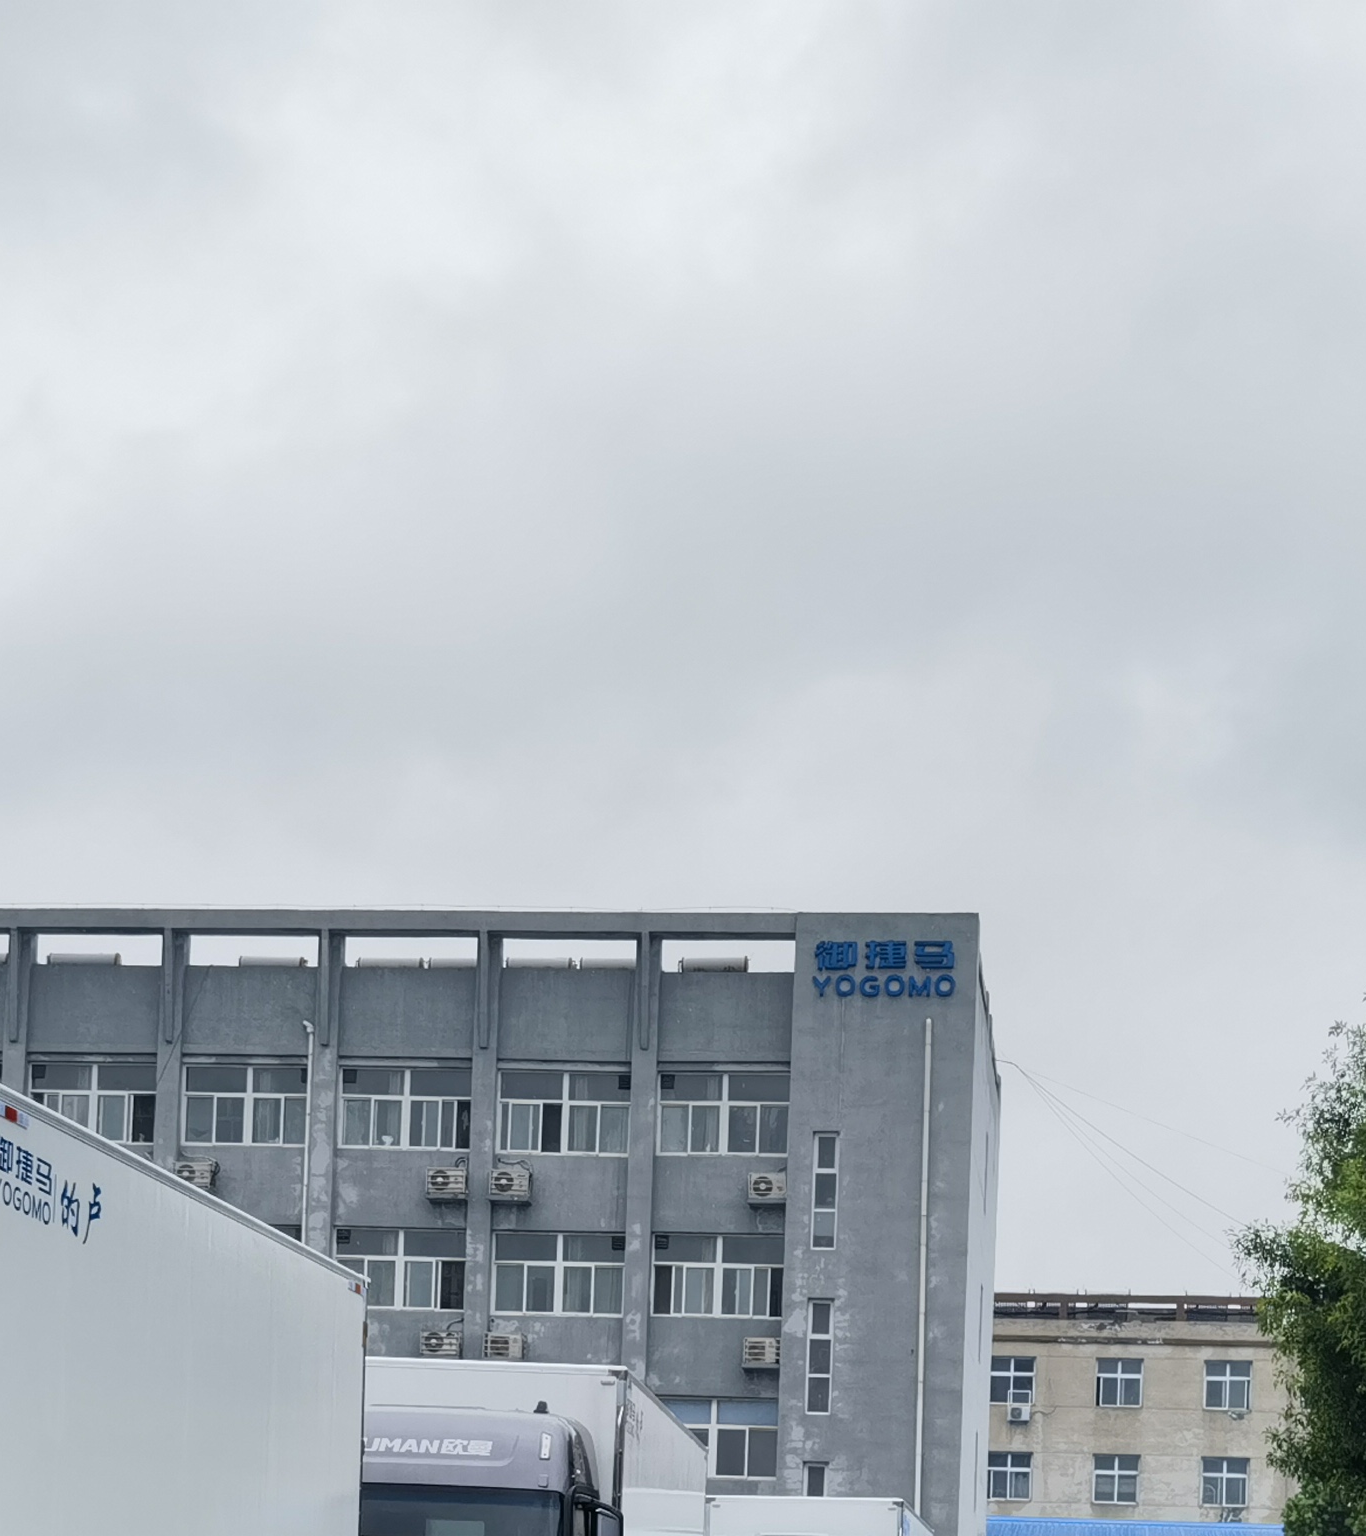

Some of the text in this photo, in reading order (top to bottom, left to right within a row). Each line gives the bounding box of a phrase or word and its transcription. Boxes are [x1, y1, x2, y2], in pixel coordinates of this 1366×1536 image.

[815, 940, 955, 971] 御捷马
[812, 974, 956, 997] YOGOMO
[362, 1437, 494, 1457] UMAN欧曼
